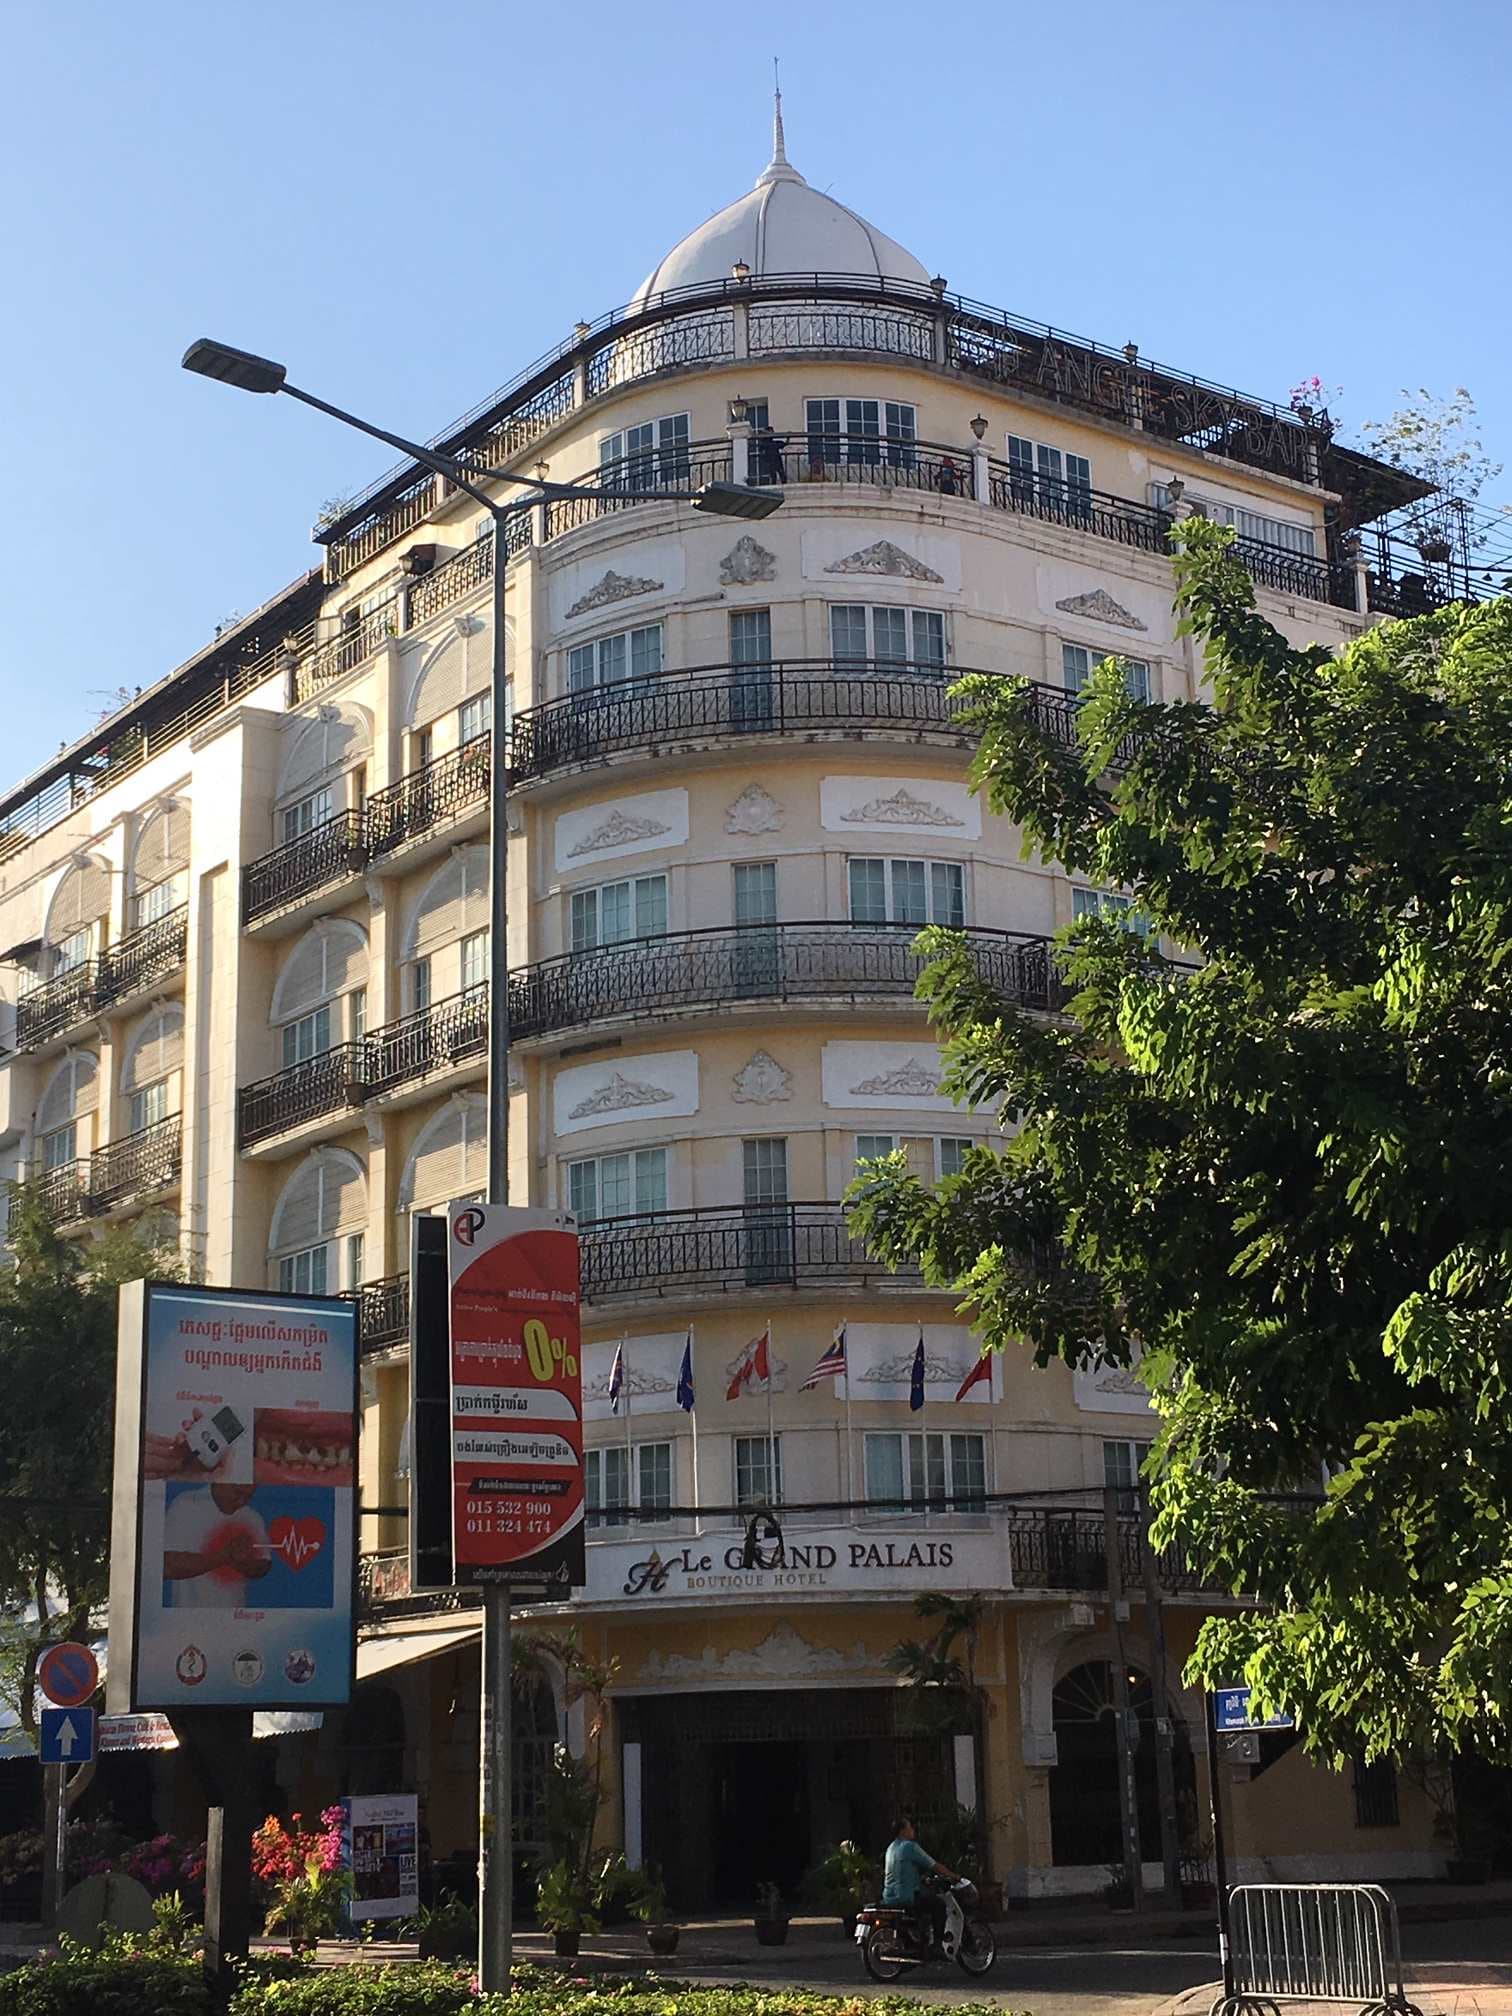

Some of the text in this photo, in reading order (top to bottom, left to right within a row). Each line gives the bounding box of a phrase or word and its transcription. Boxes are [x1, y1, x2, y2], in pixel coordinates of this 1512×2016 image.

[523, 1318, 578, 1382] 0%
[466, 1500, 551, 1516] 015 532 900
[466, 1519, 551, 1533] 011 324 474
[681, 1548, 712, 1573] Le
[848, 1543, 954, 1568] PALAIS
[687, 1573, 827, 1589] BOUTIQUE HOTEL
